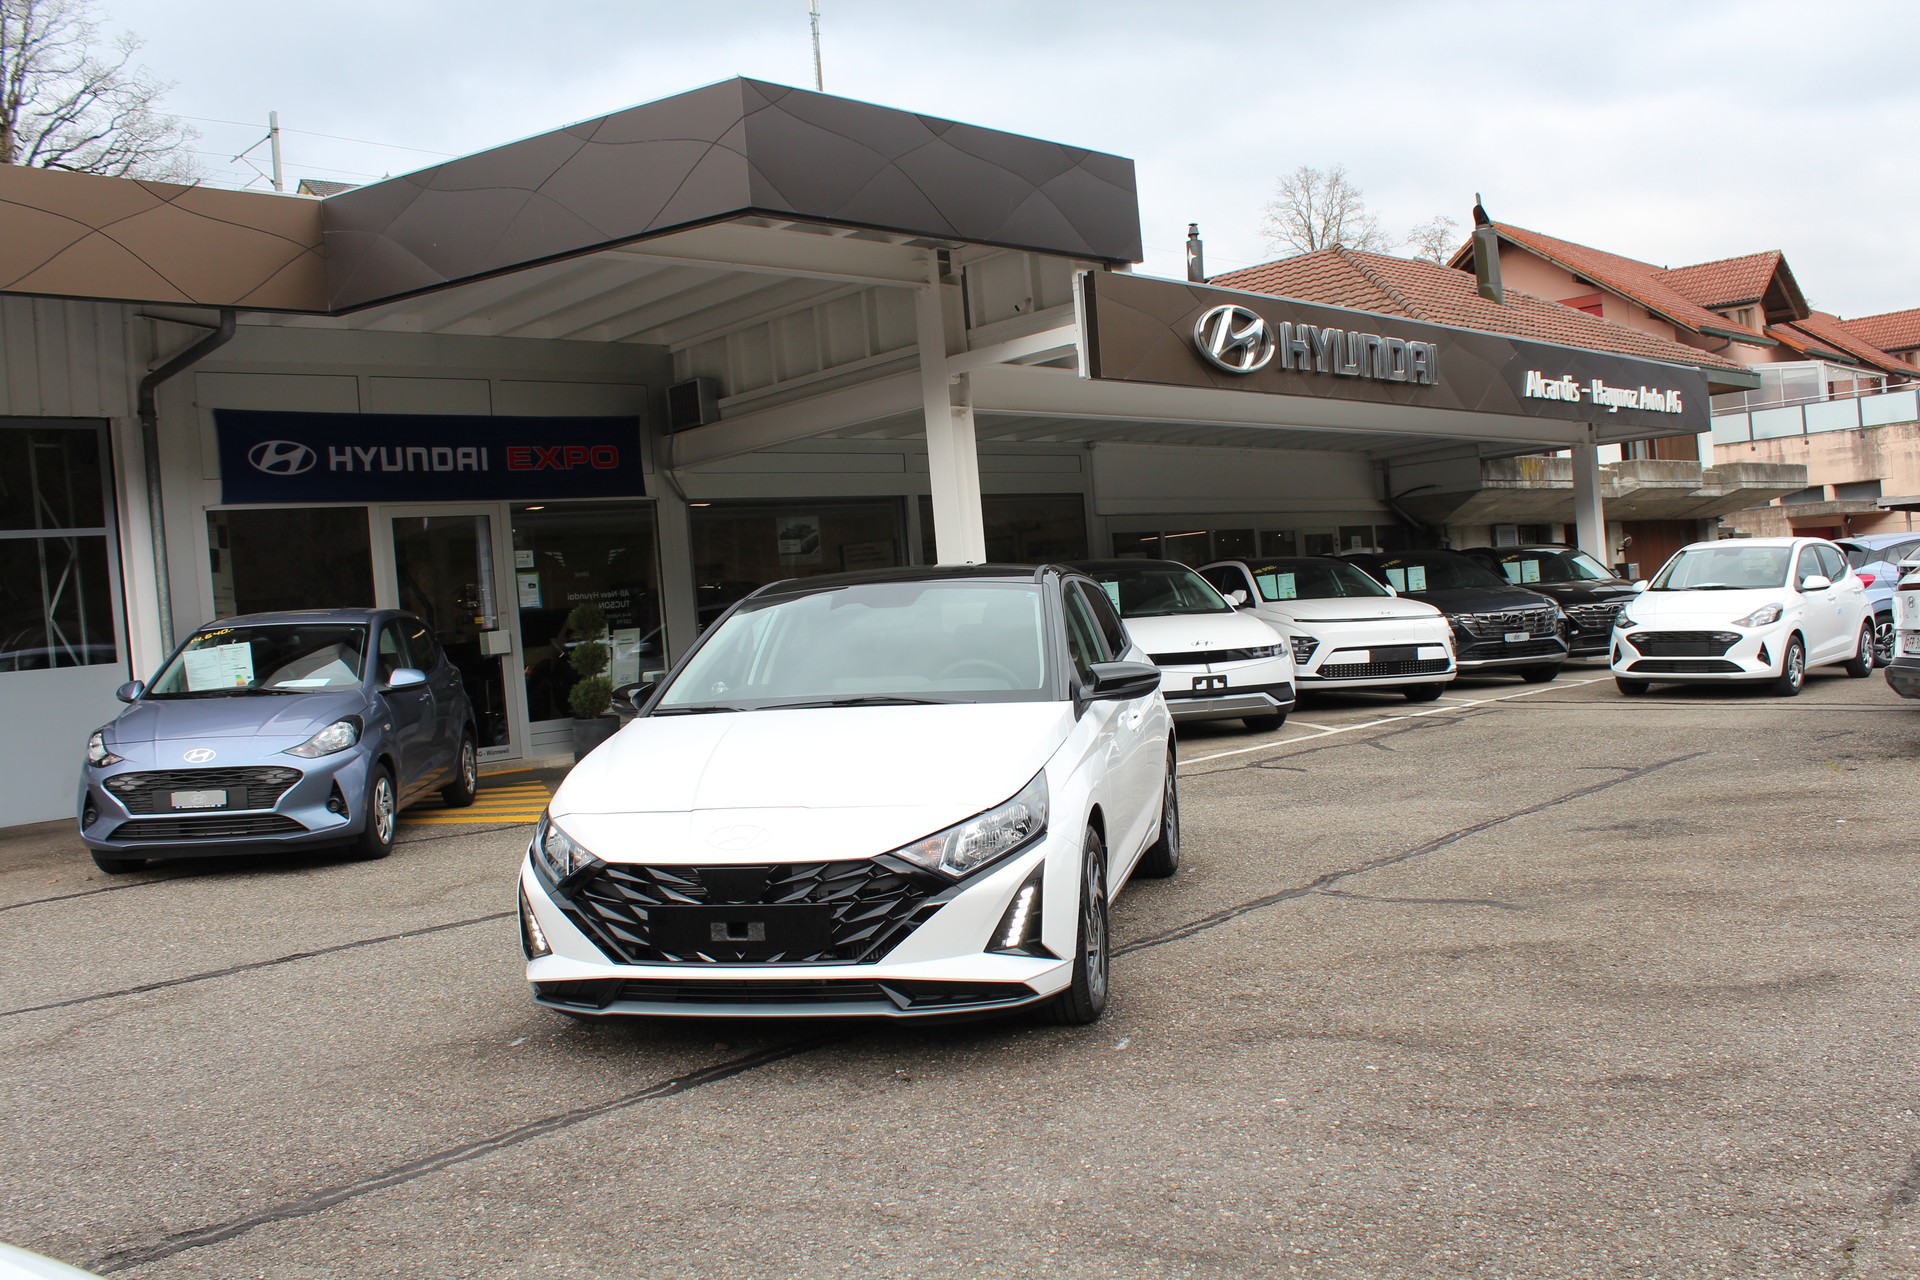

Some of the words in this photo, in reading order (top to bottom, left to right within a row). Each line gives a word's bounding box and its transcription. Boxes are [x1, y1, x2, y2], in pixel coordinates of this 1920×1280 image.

[1279, 321, 1439, 386] HYUNDAI
[1525, 370, 1580, 402] Alcardis
[1591, 379, 1640, 413] Haymoz
[1639, 385, 1666, 412] Auto
[1665, 389, 1683, 414] AG
[328, 446, 489, 472] HYUNDAI
[506, 445, 620, 471] EXPO
